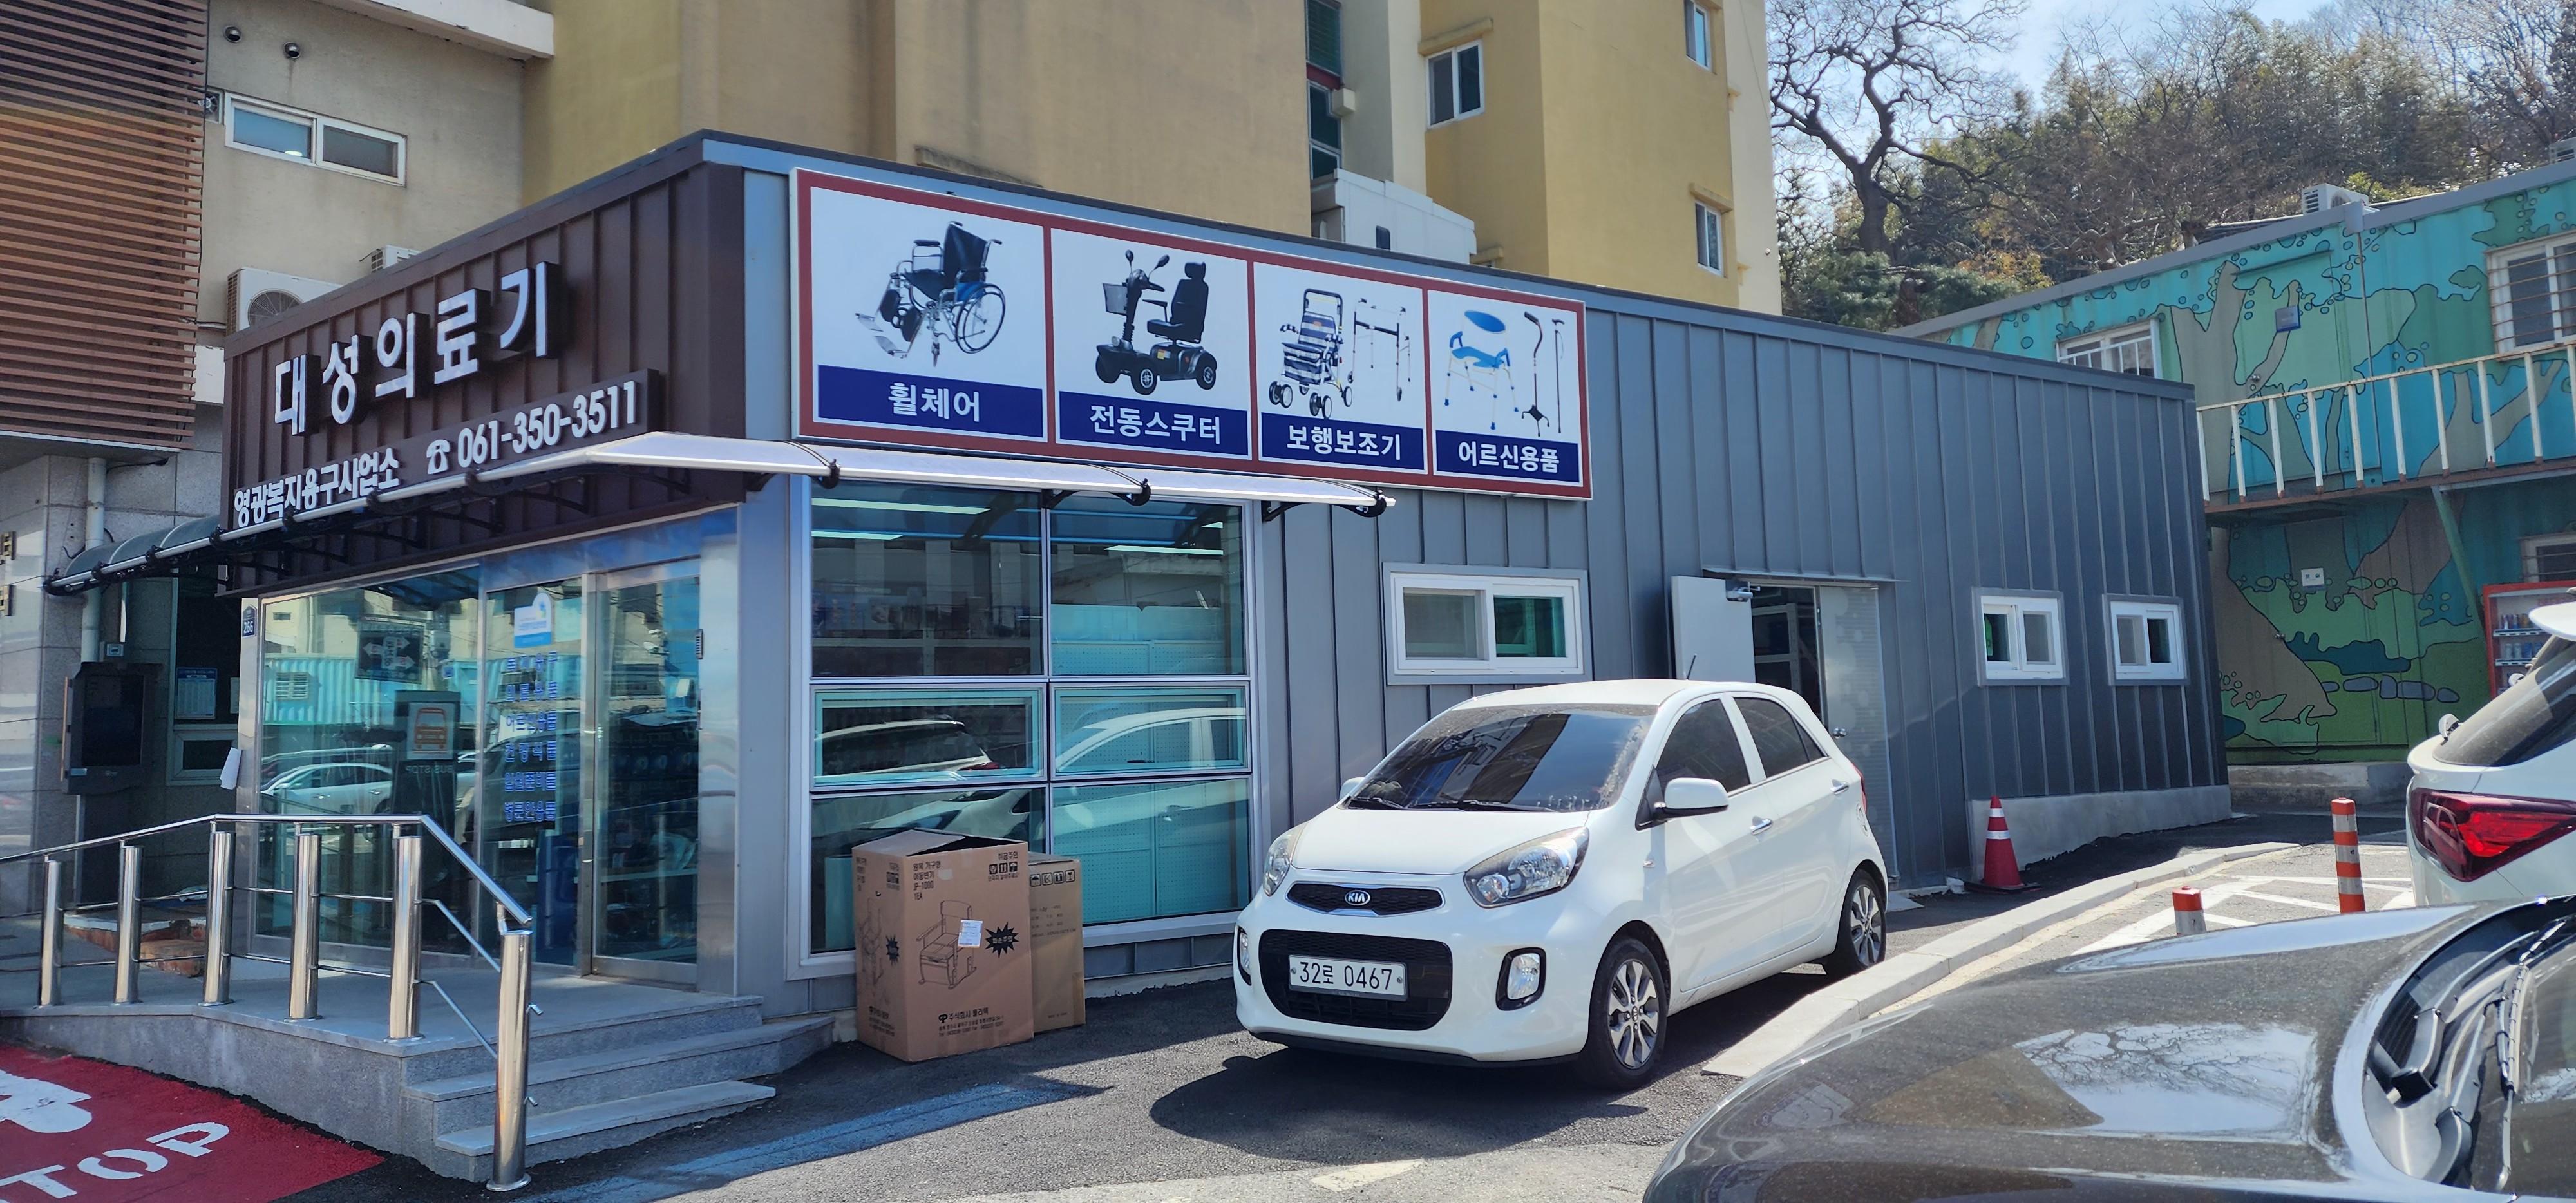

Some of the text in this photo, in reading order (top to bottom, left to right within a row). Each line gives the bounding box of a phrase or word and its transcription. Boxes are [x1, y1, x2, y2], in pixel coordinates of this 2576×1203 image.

[275, 261, 547, 436] 대성의료기
[888, 382, 980, 422] 휠체어
[1090, 404, 1221, 444] 전동스쿠터
[1287, 424, 1401, 460] 보행보조기
[234, 381, 636, 528] 영광복지용구사업소 061-350-3511
[1458, 440, 1560, 473] 어르신용품
[1347, 893, 1366, 902] KIA
[1300, 961, 1392, 990] 32로 0467
[0, 1122, 229, 1202] TOP
